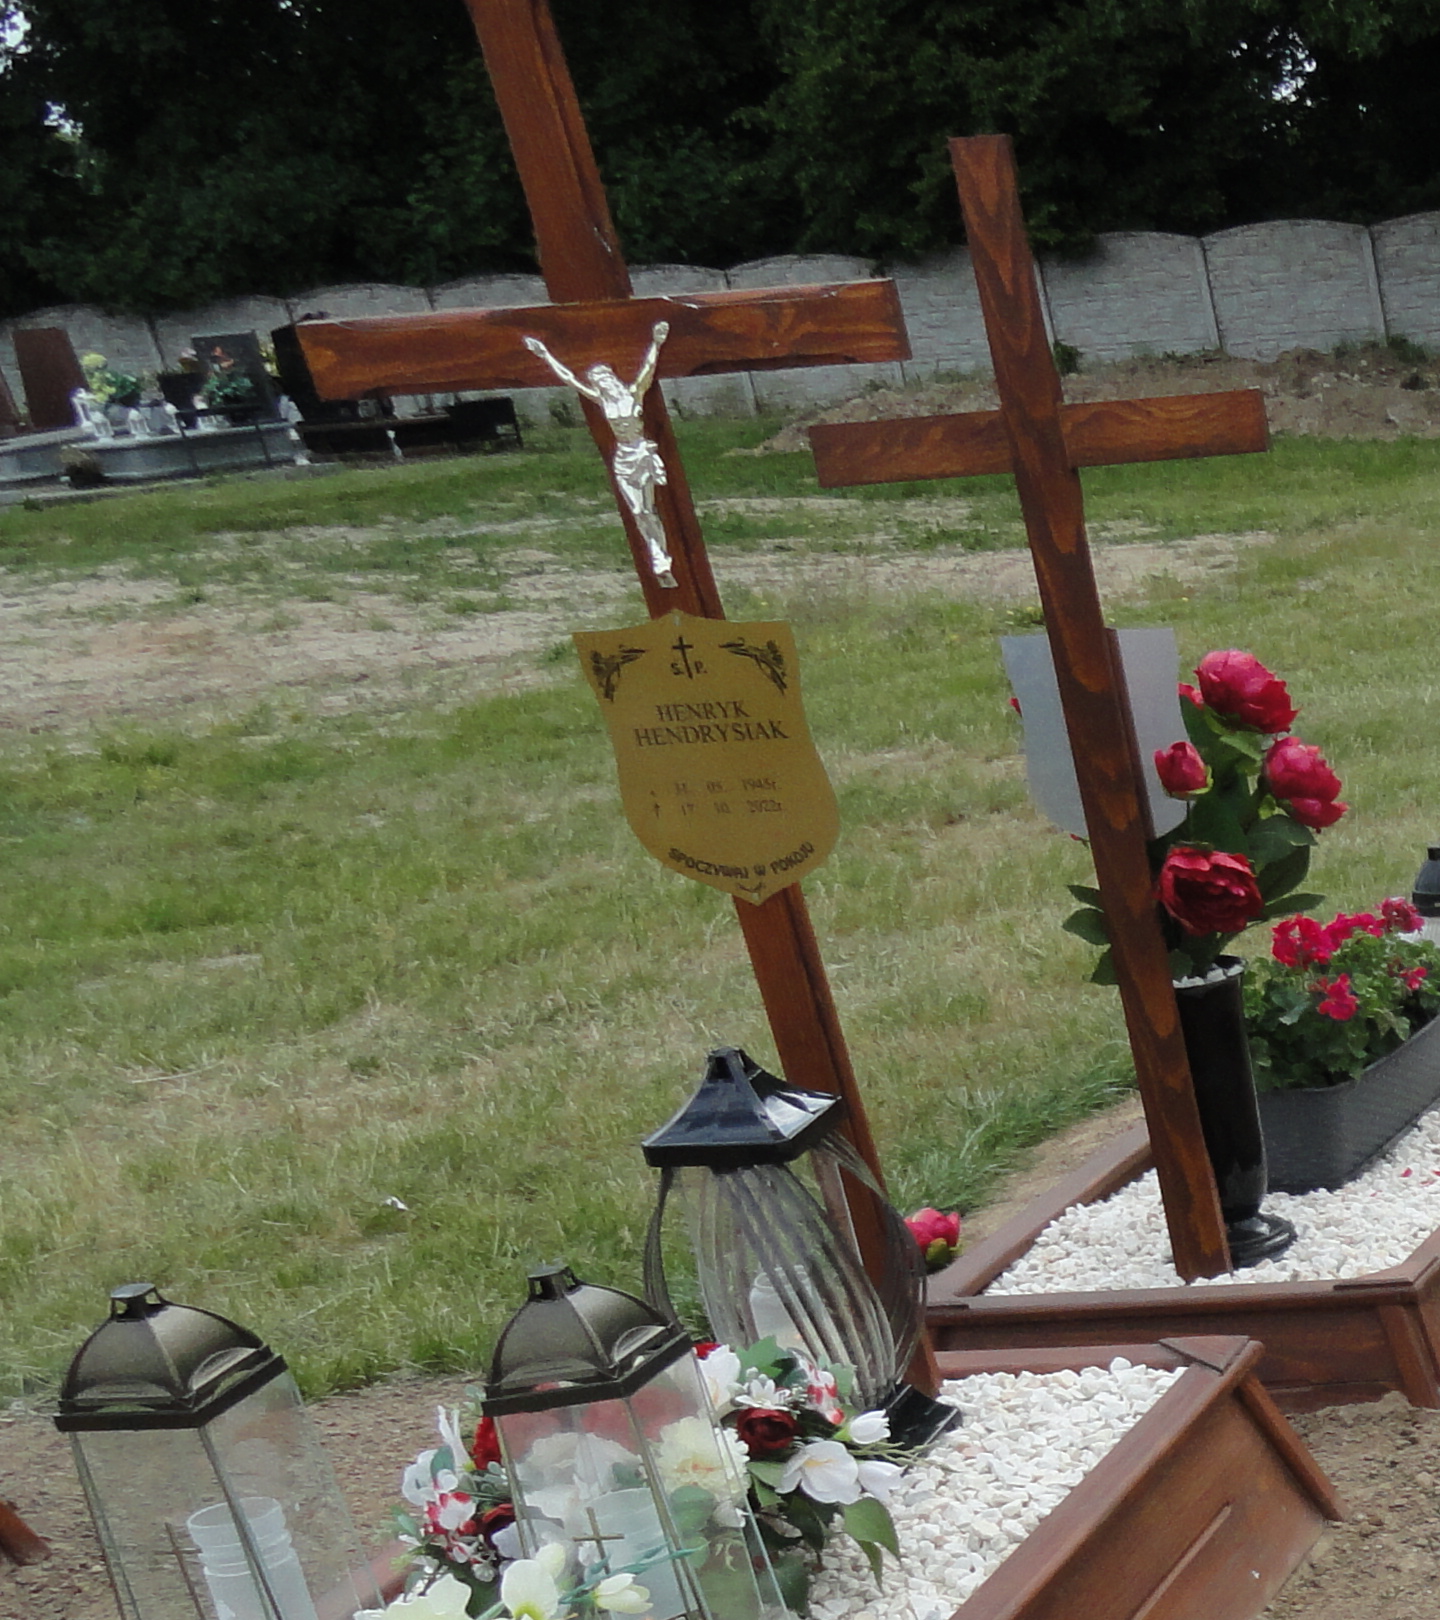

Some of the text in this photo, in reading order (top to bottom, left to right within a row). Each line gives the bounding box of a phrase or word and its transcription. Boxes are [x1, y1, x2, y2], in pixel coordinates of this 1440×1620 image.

[655, 700, 751, 722] HENRYK
[634, 719, 789, 747] HENDRYSIAK
[770, 841, 815, 874] POKOJU
